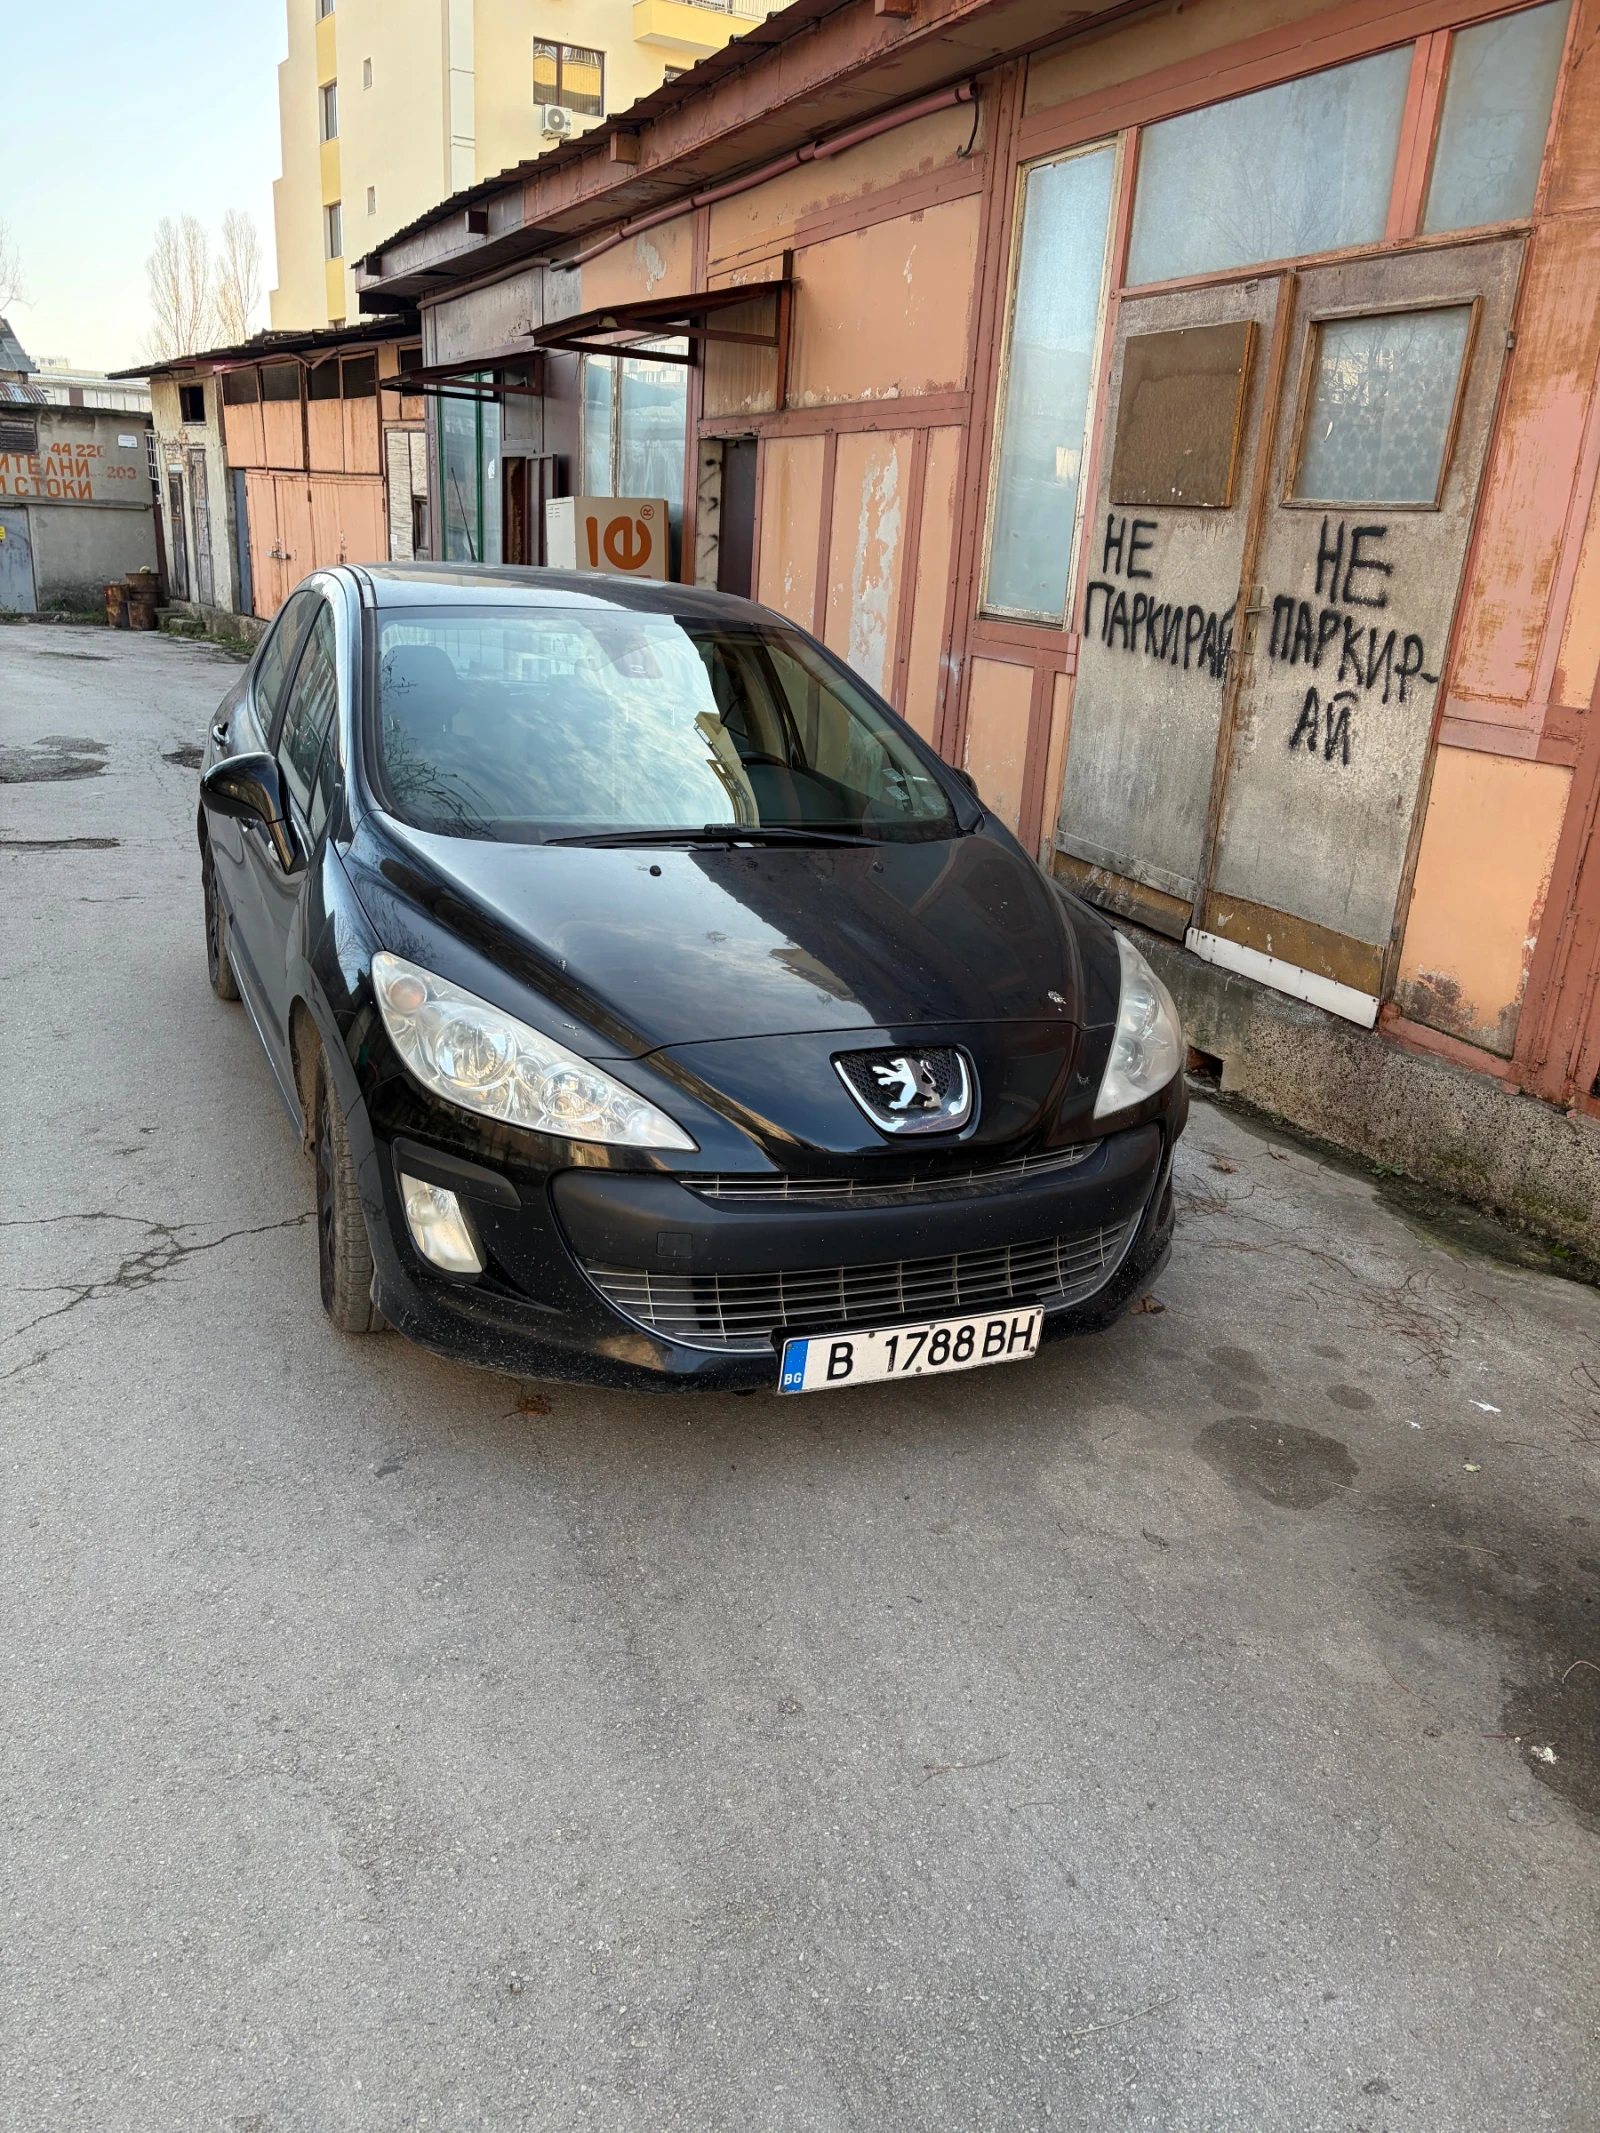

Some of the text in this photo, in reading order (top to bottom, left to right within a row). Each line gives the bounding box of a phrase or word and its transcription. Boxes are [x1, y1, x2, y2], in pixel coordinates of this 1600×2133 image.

[14, 477, 93, 499] СТОКИ
[1102, 513, 1158, 578] НЕ
[1315, 515, 1394, 608] НЕ
[1289, 686, 1359, 765] АЙ
[784, 1372, 802, 1385] BG
[826, 1342, 854, 1381] B
[885, 1325, 975, 1372] 1788
